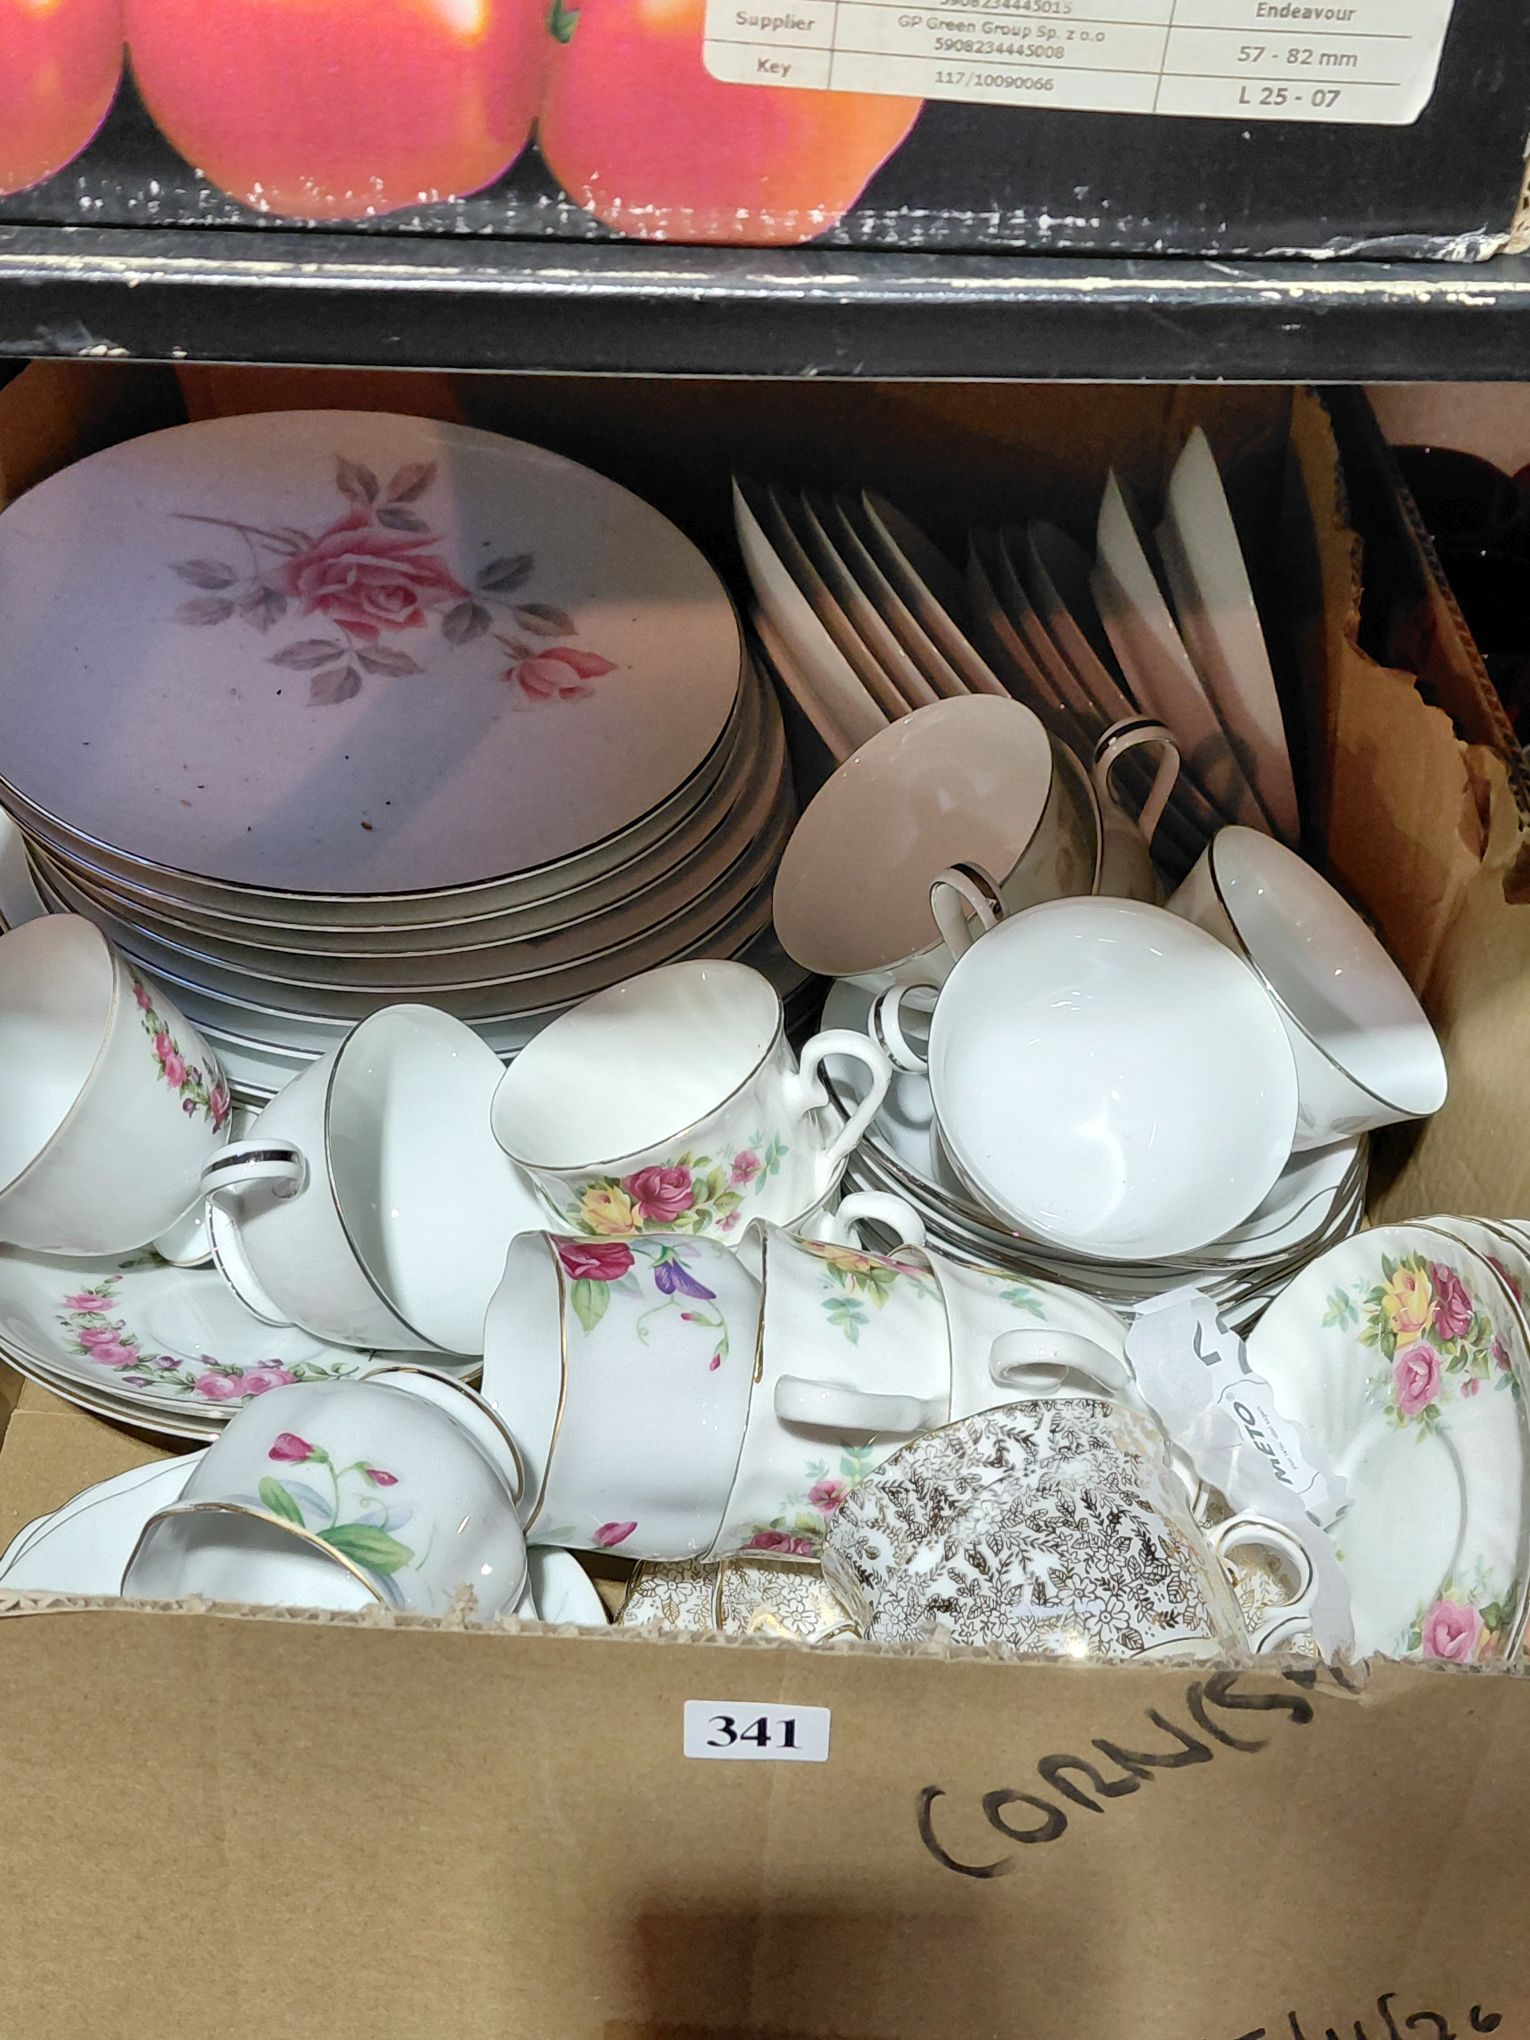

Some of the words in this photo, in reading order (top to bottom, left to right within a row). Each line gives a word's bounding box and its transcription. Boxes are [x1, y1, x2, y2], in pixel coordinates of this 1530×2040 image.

[735, 10, 815, 33] Supplier
[1255, 2, 1357, 22] Endeavour
[897, 15, 923, 29] GP
[926, 17, 977, 34] Green
[981, 21, 1032, 39] Group
[1066, 30, 1076, 41] z
[933, 37, 1066, 60] 5908234445008
[1236, 45, 1265, 64] 57
[1286, 48, 1314, 67] 82
[1318, 52, 1359, 68] mm
[756, 57, 792, 78] Key
[934, 71, 1055, 92] 117/10090066
[1238, 85, 1252, 106] L
[1259, 86, 1289, 106] 25
[1311, 89, 1342, 109] 07
[1233, 1401, 1293, 1486] METO
[705, 1715, 803, 1750] 341
